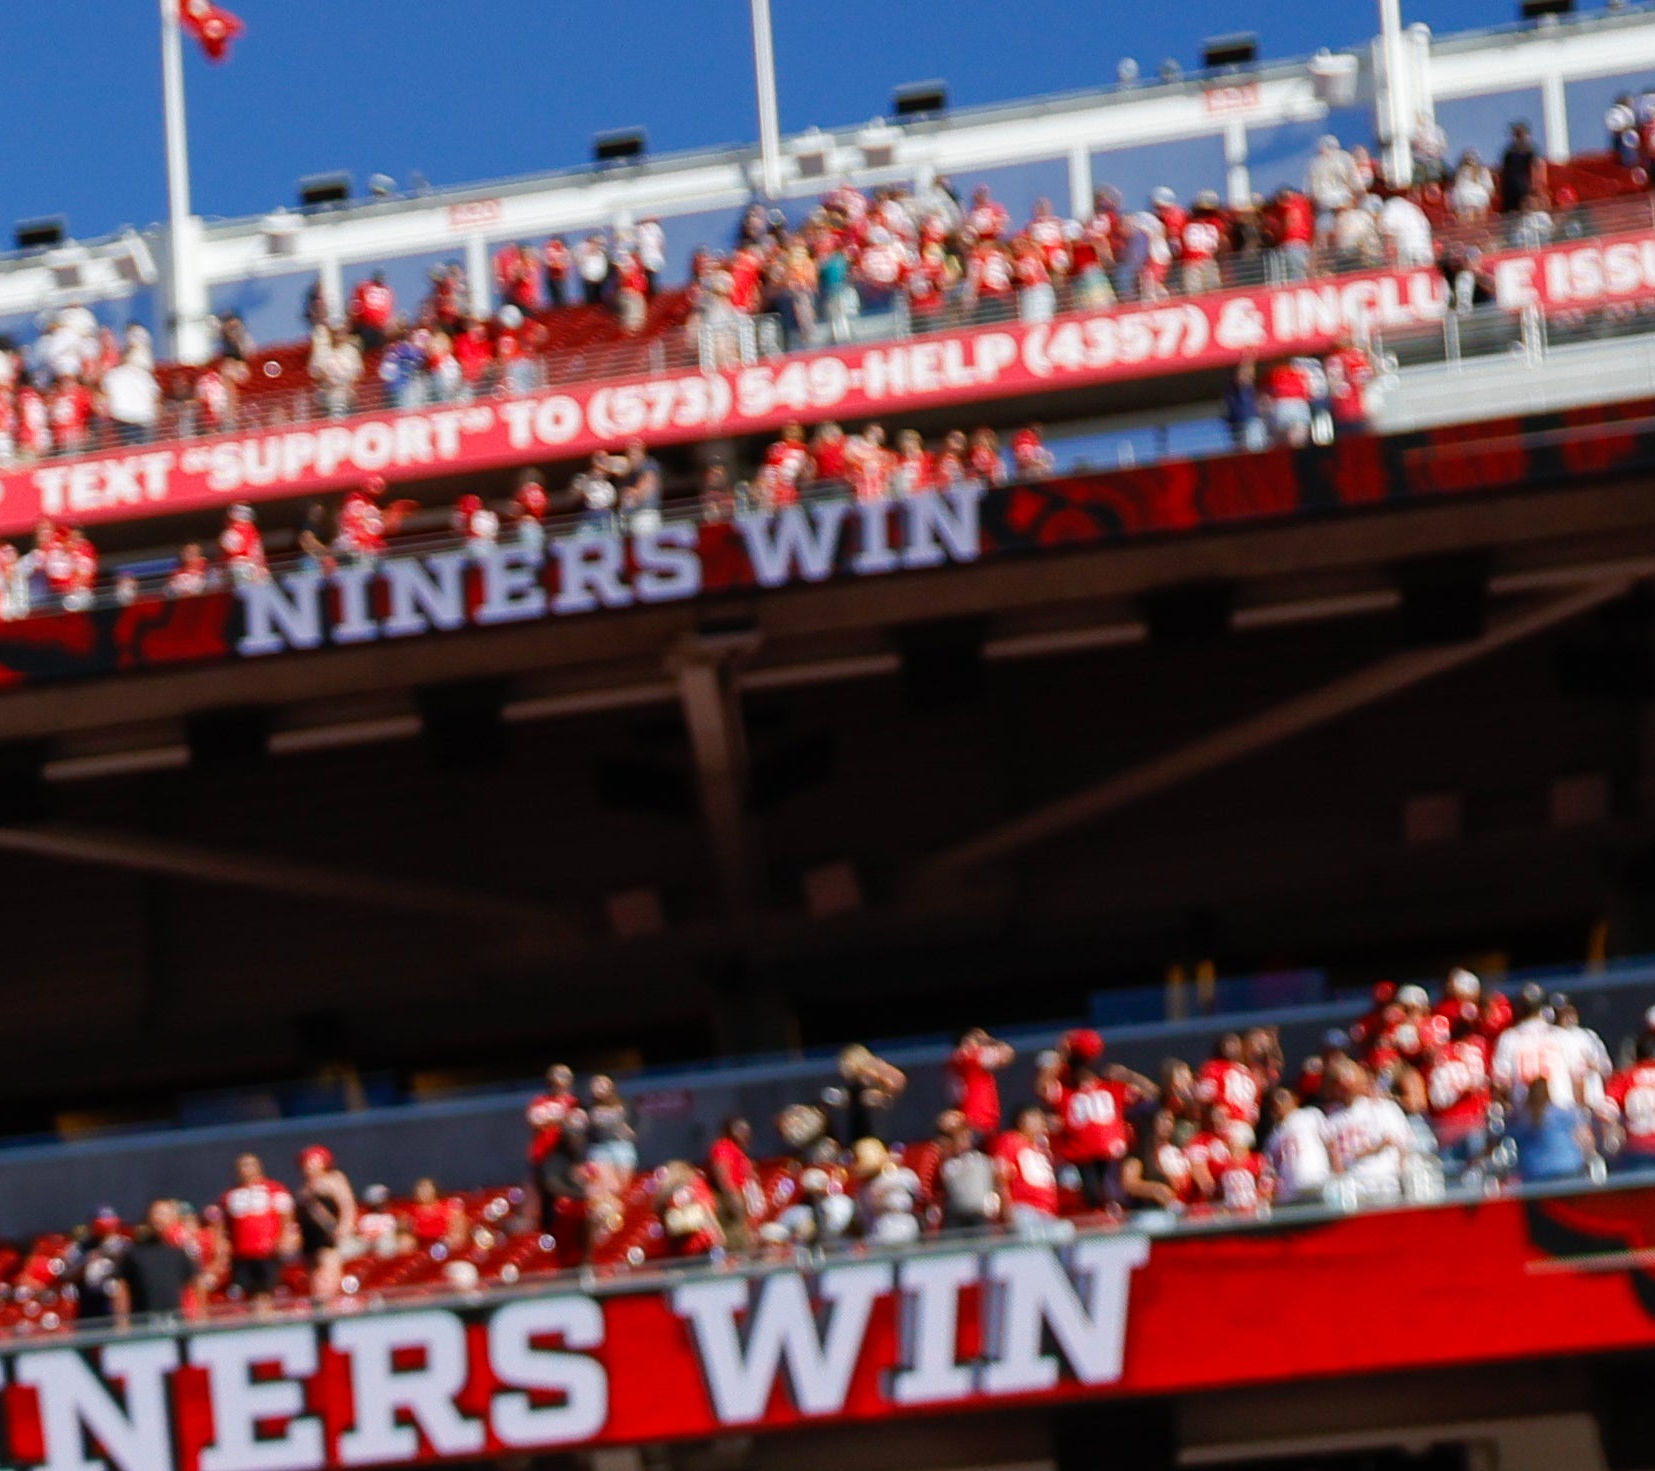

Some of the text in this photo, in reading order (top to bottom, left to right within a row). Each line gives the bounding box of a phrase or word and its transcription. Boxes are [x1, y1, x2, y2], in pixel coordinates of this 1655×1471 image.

[33, 449, 175, 516] TEXT
[501, 393, 583, 449] TO
[587, 372, 733, 440] (573)
[736, 333, 1018, 418] 549-HELP
[1021, 302, 1211, 378] (4357)
[1214, 297, 1267, 349] &
[1271, 255, 1539, 343] INCLUE
[236, 484, 989, 659] NINERS WIN
[673, 1231, 1153, 1425] WIN
